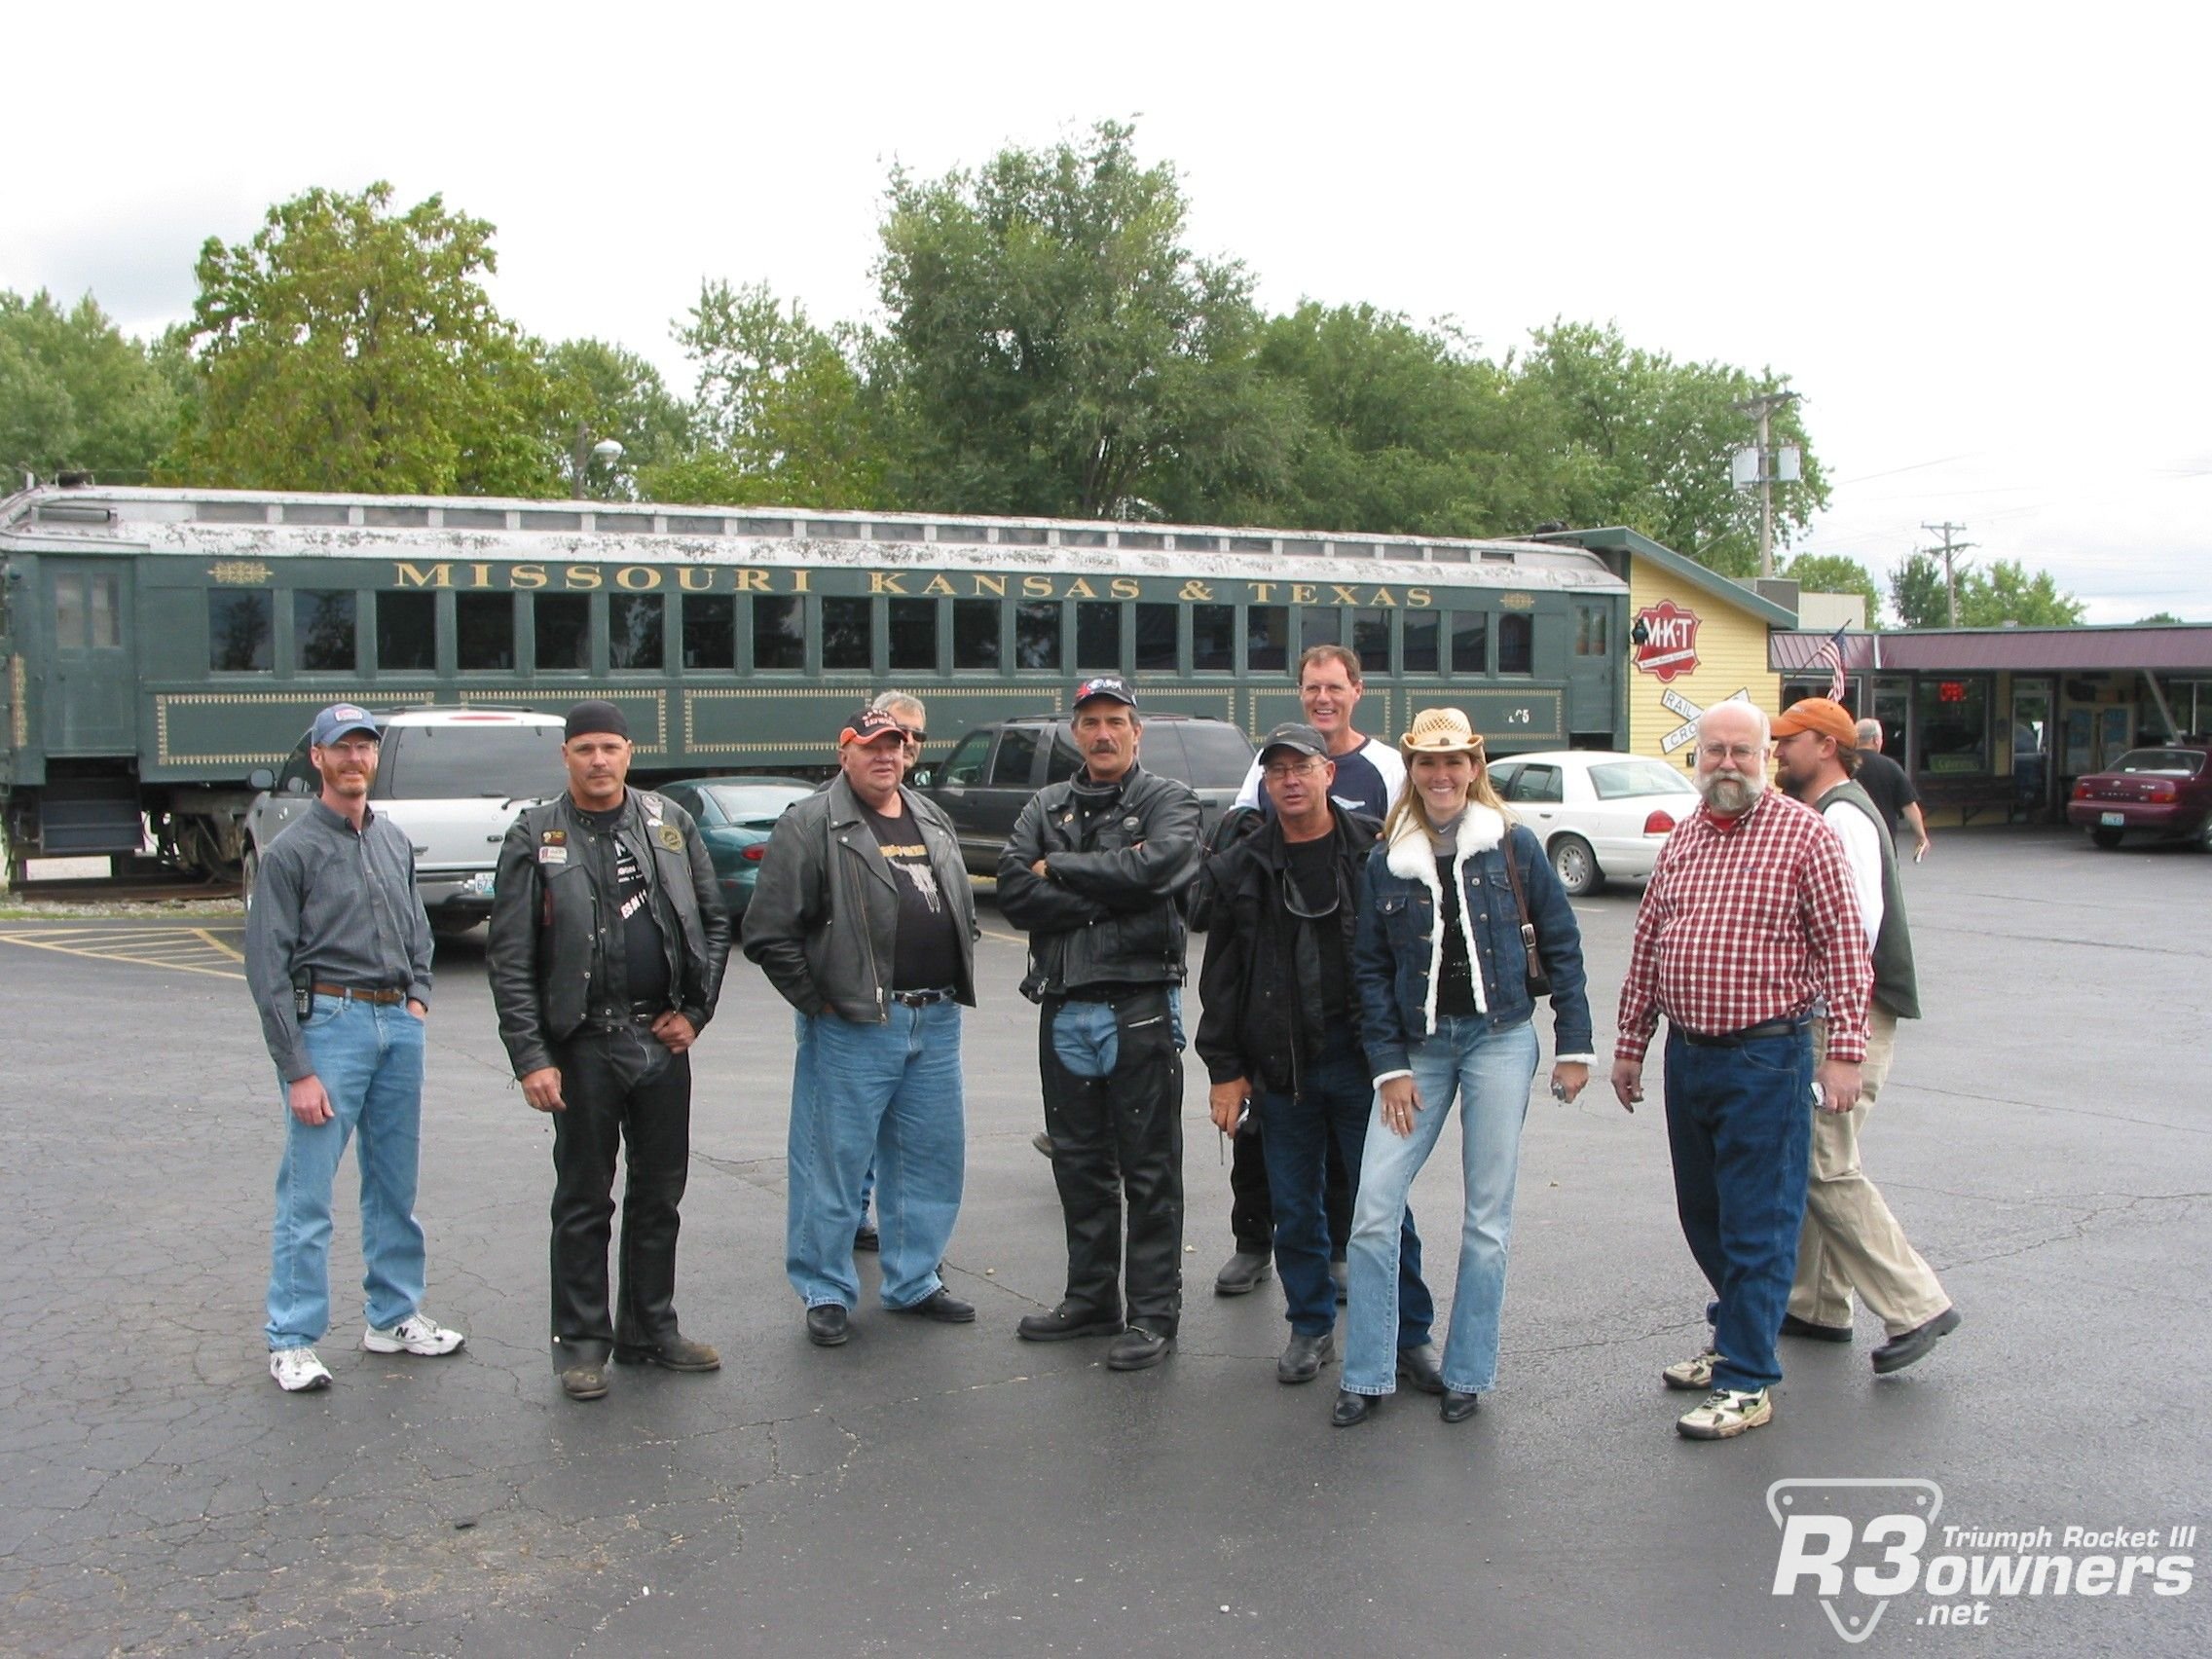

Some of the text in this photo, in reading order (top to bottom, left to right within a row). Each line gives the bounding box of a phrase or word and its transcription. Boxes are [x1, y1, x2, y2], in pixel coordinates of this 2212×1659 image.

[392, 563, 1432, 608] MISSOURI KANSAS & TEXAS
[1666, 693, 1693, 718] RAIL
